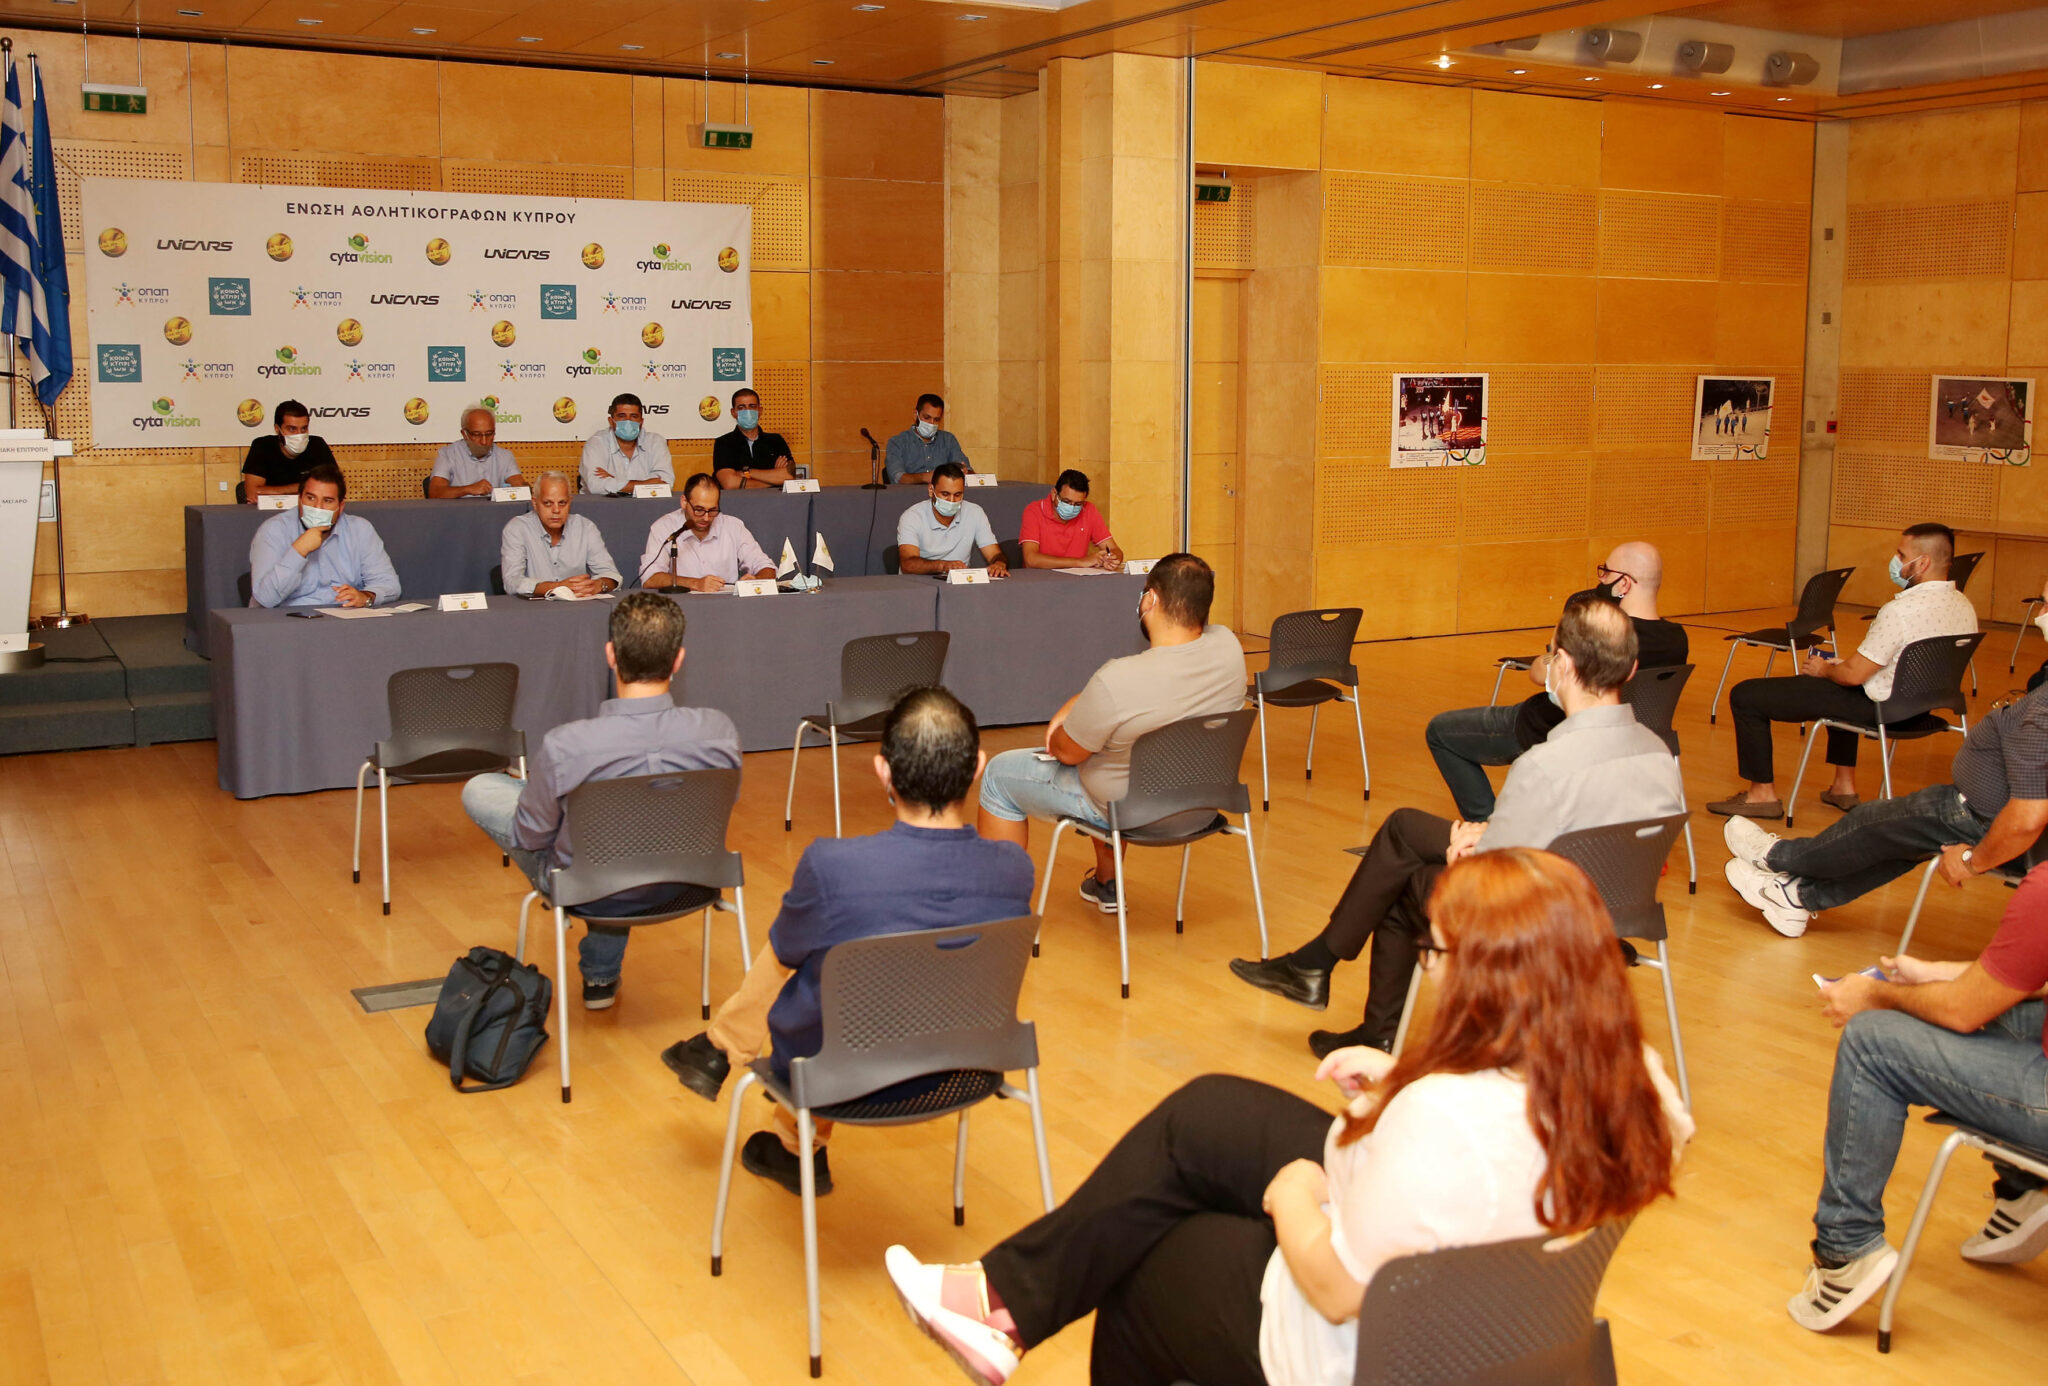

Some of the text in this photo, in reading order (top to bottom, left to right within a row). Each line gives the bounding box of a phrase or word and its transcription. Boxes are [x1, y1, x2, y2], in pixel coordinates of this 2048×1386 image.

[287, 202, 576, 224] ΕΝΩΣΗ ΑΘΛΗΤΙΚΟΓΡΑΦΩΝ ΚΥΠΡΟΥ
[330, 251, 393, 266] cytavision
[637, 260, 692, 273] cytavision
[257, 363, 322, 379] cytavision
[566, 364, 623, 378] cytavision
[133, 415, 200, 431] cytavision
